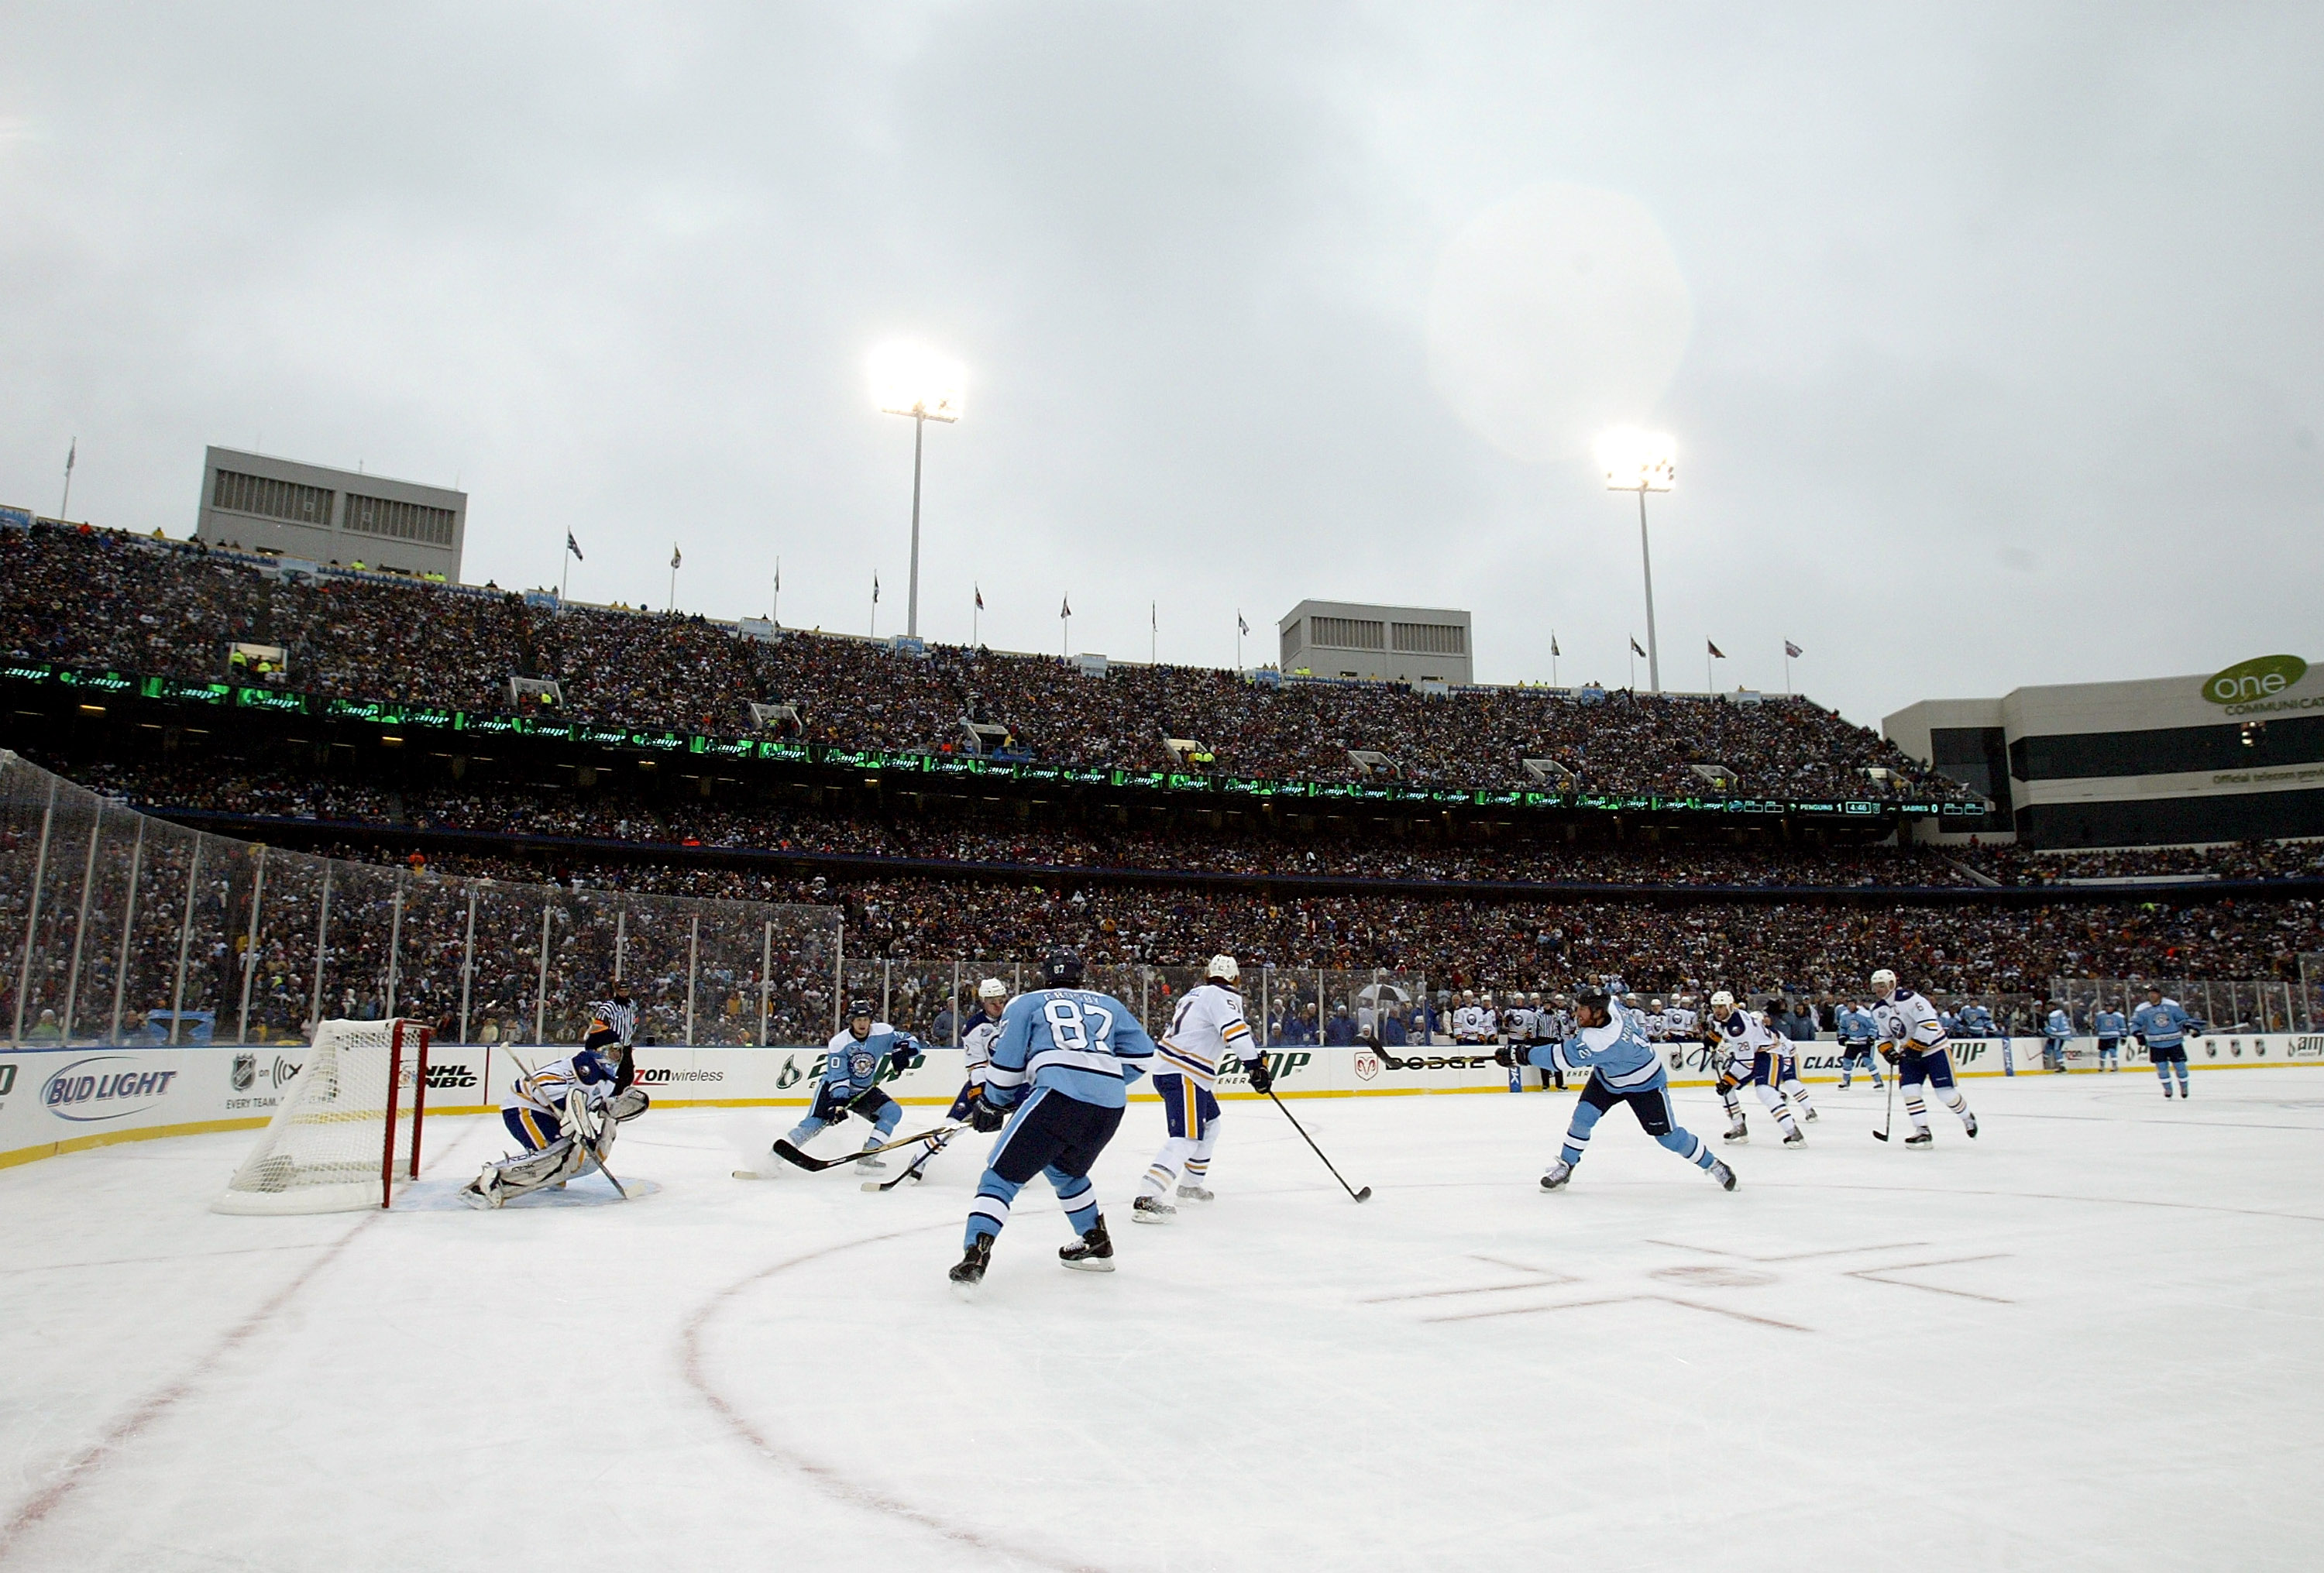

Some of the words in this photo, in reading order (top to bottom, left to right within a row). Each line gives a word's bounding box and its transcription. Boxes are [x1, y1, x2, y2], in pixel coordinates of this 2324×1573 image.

[2214, 673, 2286, 699] one
[1931, 804, 1937, 813] 0
[1043, 998, 1113, 1052] 87
[1803, 1056, 1867, 1070] CLASIC
[671, 1069, 724, 1082] wireless
[46, 1076, 95, 1106] BUD
[96, 1070, 177, 1099] LIGHT
[225, 1098, 250, 1110] EVERY
